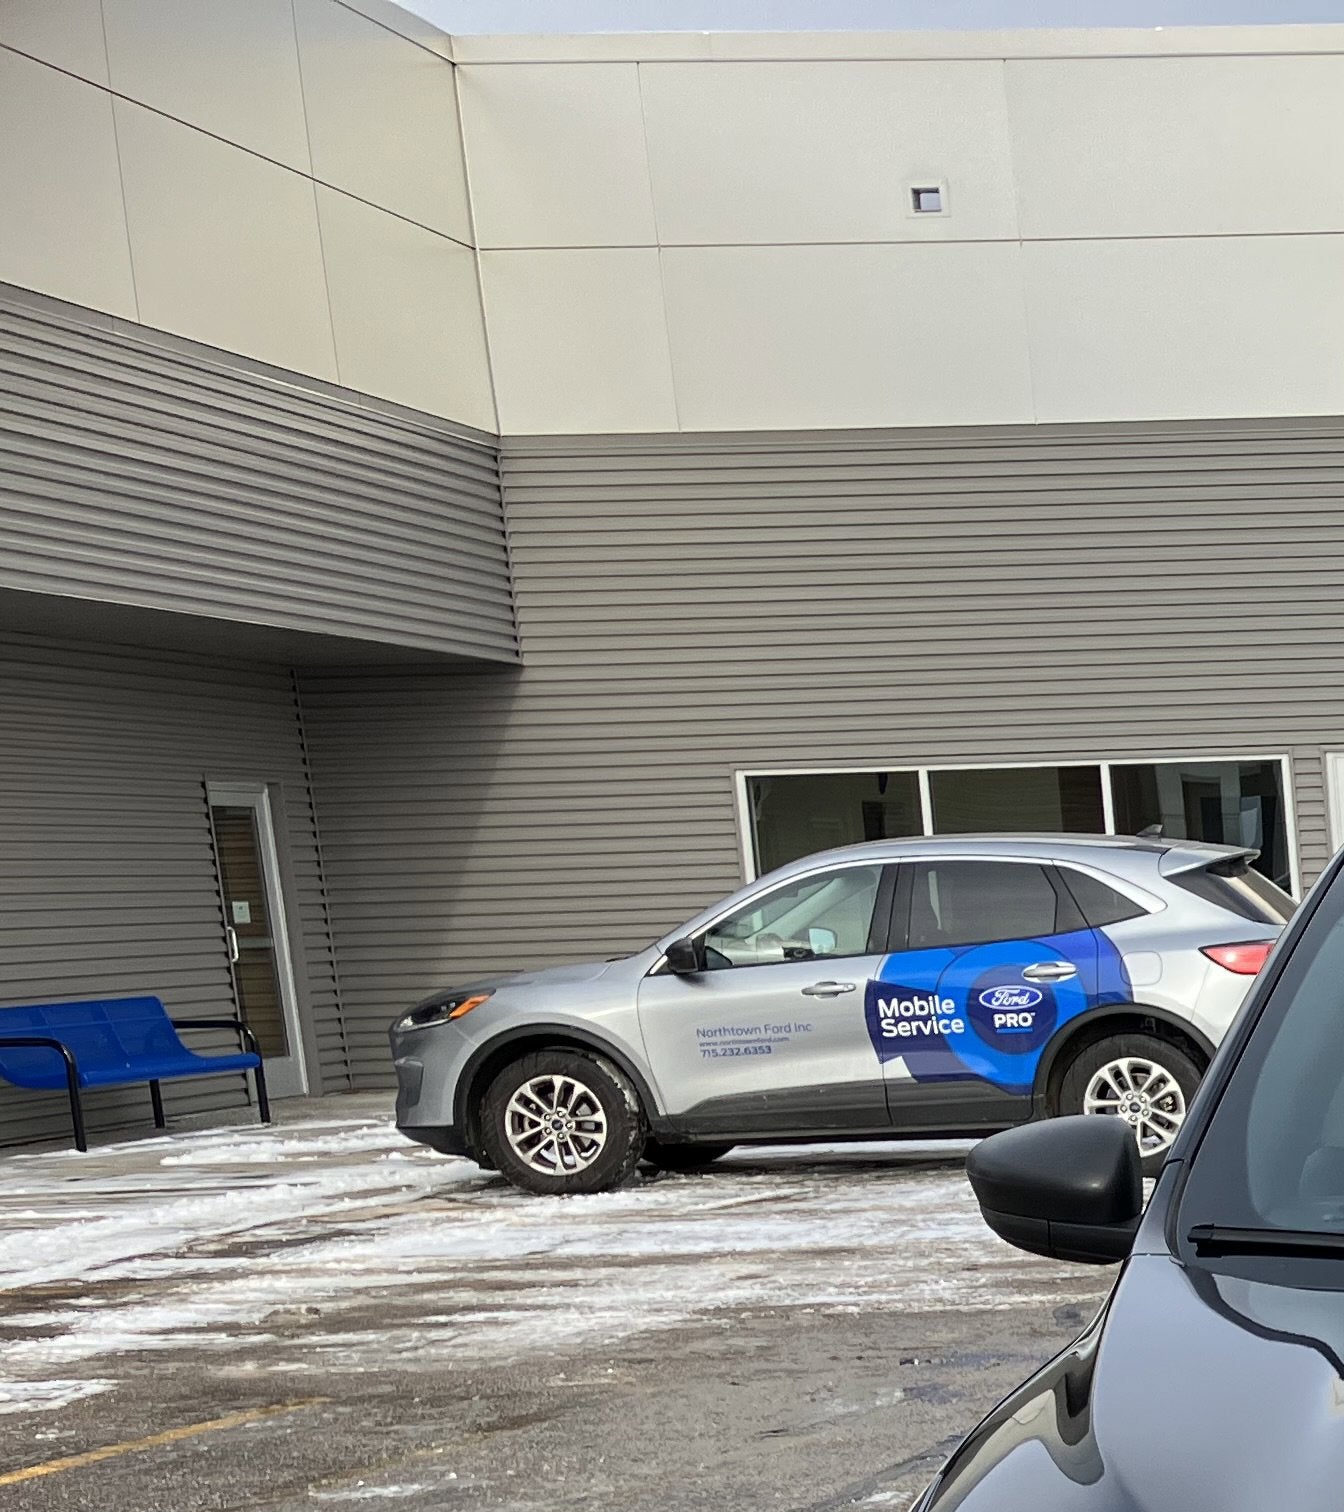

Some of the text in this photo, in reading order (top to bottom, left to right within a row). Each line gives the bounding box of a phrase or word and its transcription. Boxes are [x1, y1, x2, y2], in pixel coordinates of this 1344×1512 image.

[878, 994, 956, 1018] Mobile
[991, 988, 1030, 1006] Ford
[696, 1022, 813, 1039] Northtown Ford Inc
[880, 1016, 965, 1038] Service
[700, 1045, 772, 1059] 715.232.6353
